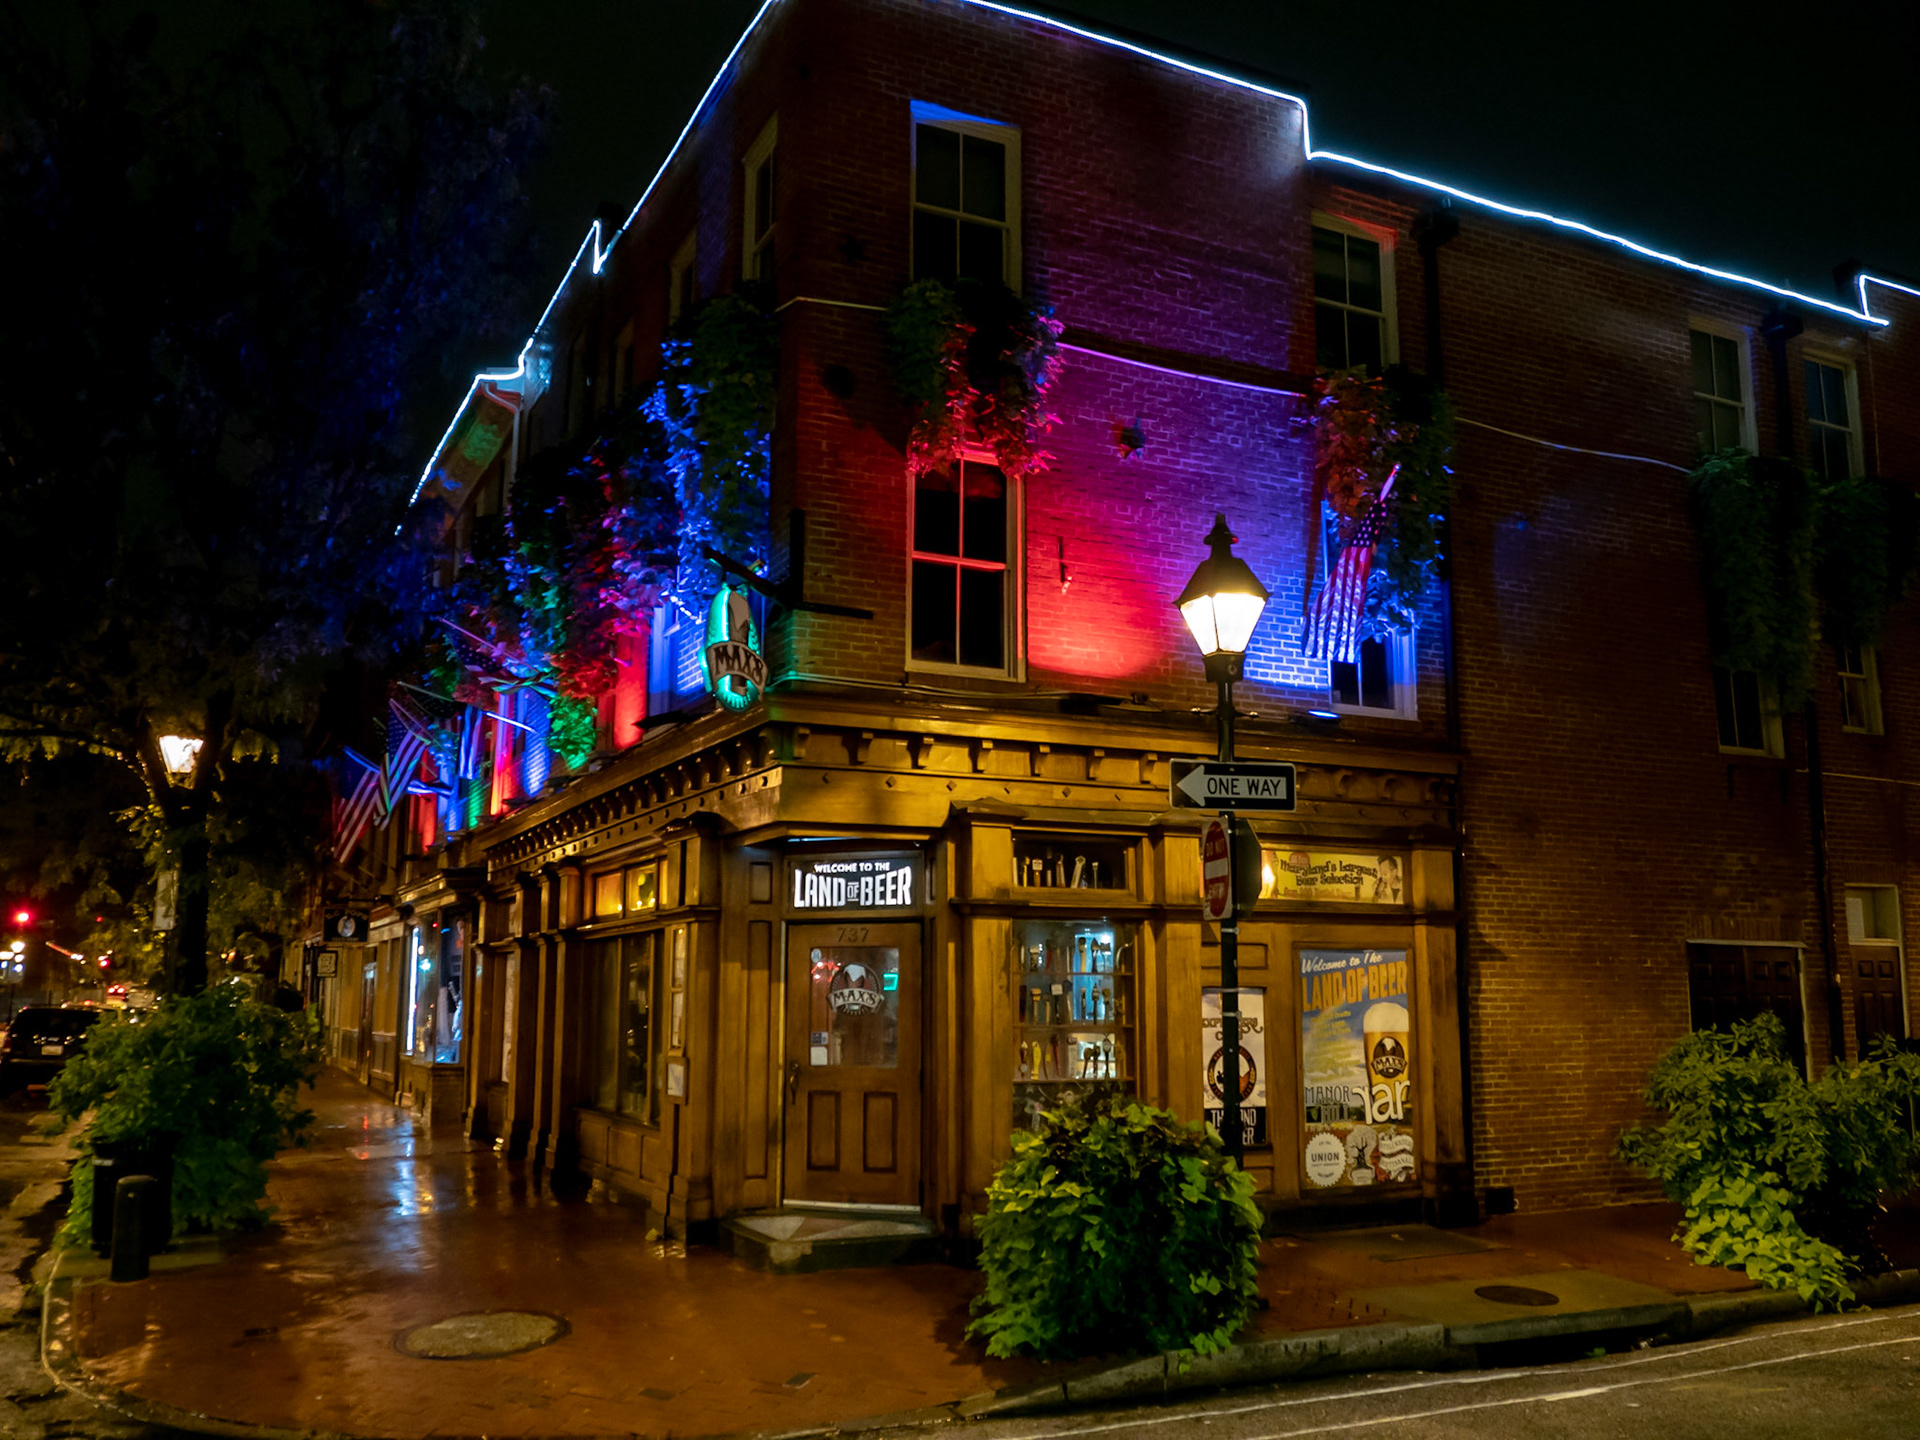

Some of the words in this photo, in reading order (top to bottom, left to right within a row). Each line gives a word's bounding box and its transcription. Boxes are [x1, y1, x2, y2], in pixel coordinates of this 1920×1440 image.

[1207, 777, 1240, 795] ONE
[1247, 778, 1281, 796] WAY
[814, 862, 857, 873] WELCOME
[859, 862, 873, 872] TO
[874, 861, 891, 871] THE
[1339, 860, 1378, 878] Largest
[794, 868, 846, 908] LAND
[847, 884, 860, 900] OF
[860, 866, 912, 906] BEER
[1296, 874, 1318, 886] Beer
[1320, 872, 1364, 886] Selection
[836, 927, 870, 943] 737
[1302, 957, 1347, 974] Welcome
[1349, 956, 1361, 966] to
[1302, 972, 1344, 1013] LAND
[1346, 968, 1367, 1003] OF
[1368, 960, 1407, 1000] BEER
[1305, 1086, 1350, 1104] MANOR
[1311, 1152, 1340, 1162] UNION
